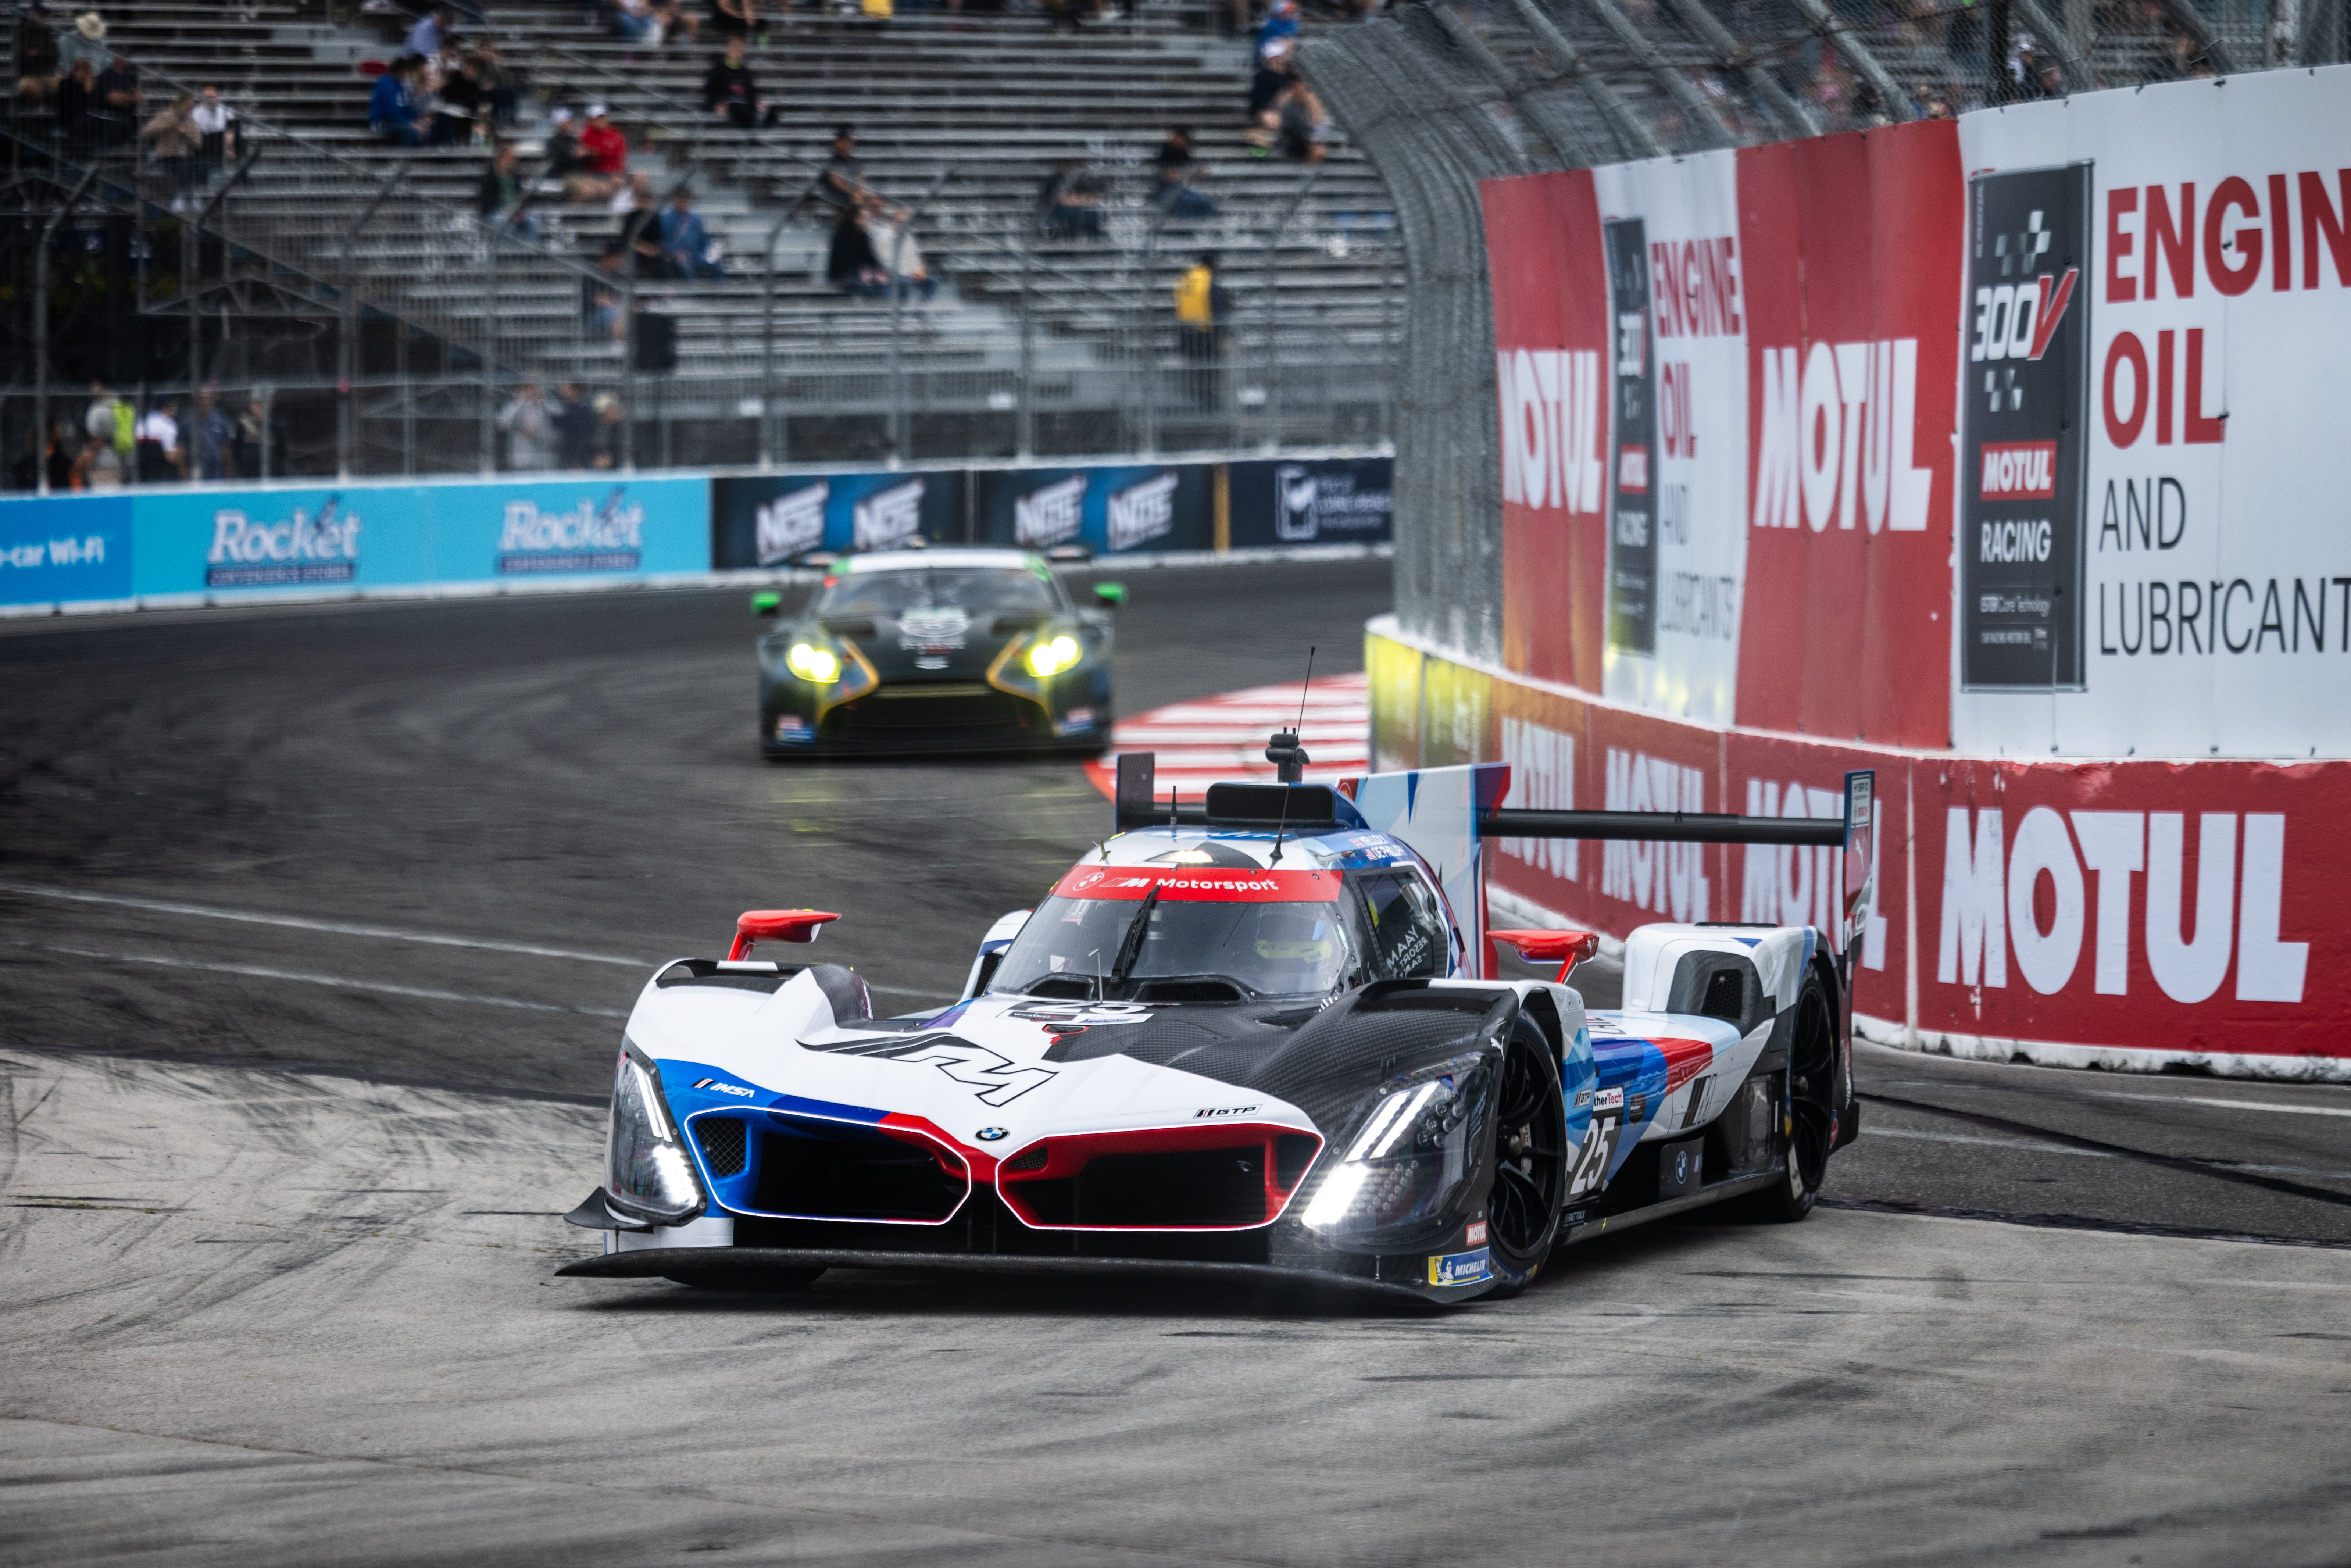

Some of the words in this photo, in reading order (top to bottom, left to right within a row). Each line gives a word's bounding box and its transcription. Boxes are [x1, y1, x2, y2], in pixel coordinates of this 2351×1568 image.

[1971, 268, 2079, 362] 300V
[1661, 362, 1697, 459] OIL
[2102, 329, 2226, 450] OIL
[1752, 336, 1934, 537] MOTUL
[1981, 449, 2052, 493] MOTUL
[207, 506, 360, 564] Rocket
[2098, 476, 2187, 553] AND
[0, 544, 46, 568] -car
[1980, 518, 2052, 563] RACING
[1602, 747, 1710, 924] MOTUL
[1157, 878, 1279, 892] Motorsport
[1937, 803, 2311, 1004] MOTUL
[709, 1082, 755, 1098] IMSA
[1216, 1107, 1257, 1115] GTP
[1581, 1092, 1591, 1103] GTP
[1569, 1116, 1616, 1195] 25
[1467, 1224, 1486, 1243] MOTUL
[1454, 1259, 1486, 1277] MICHELIN
